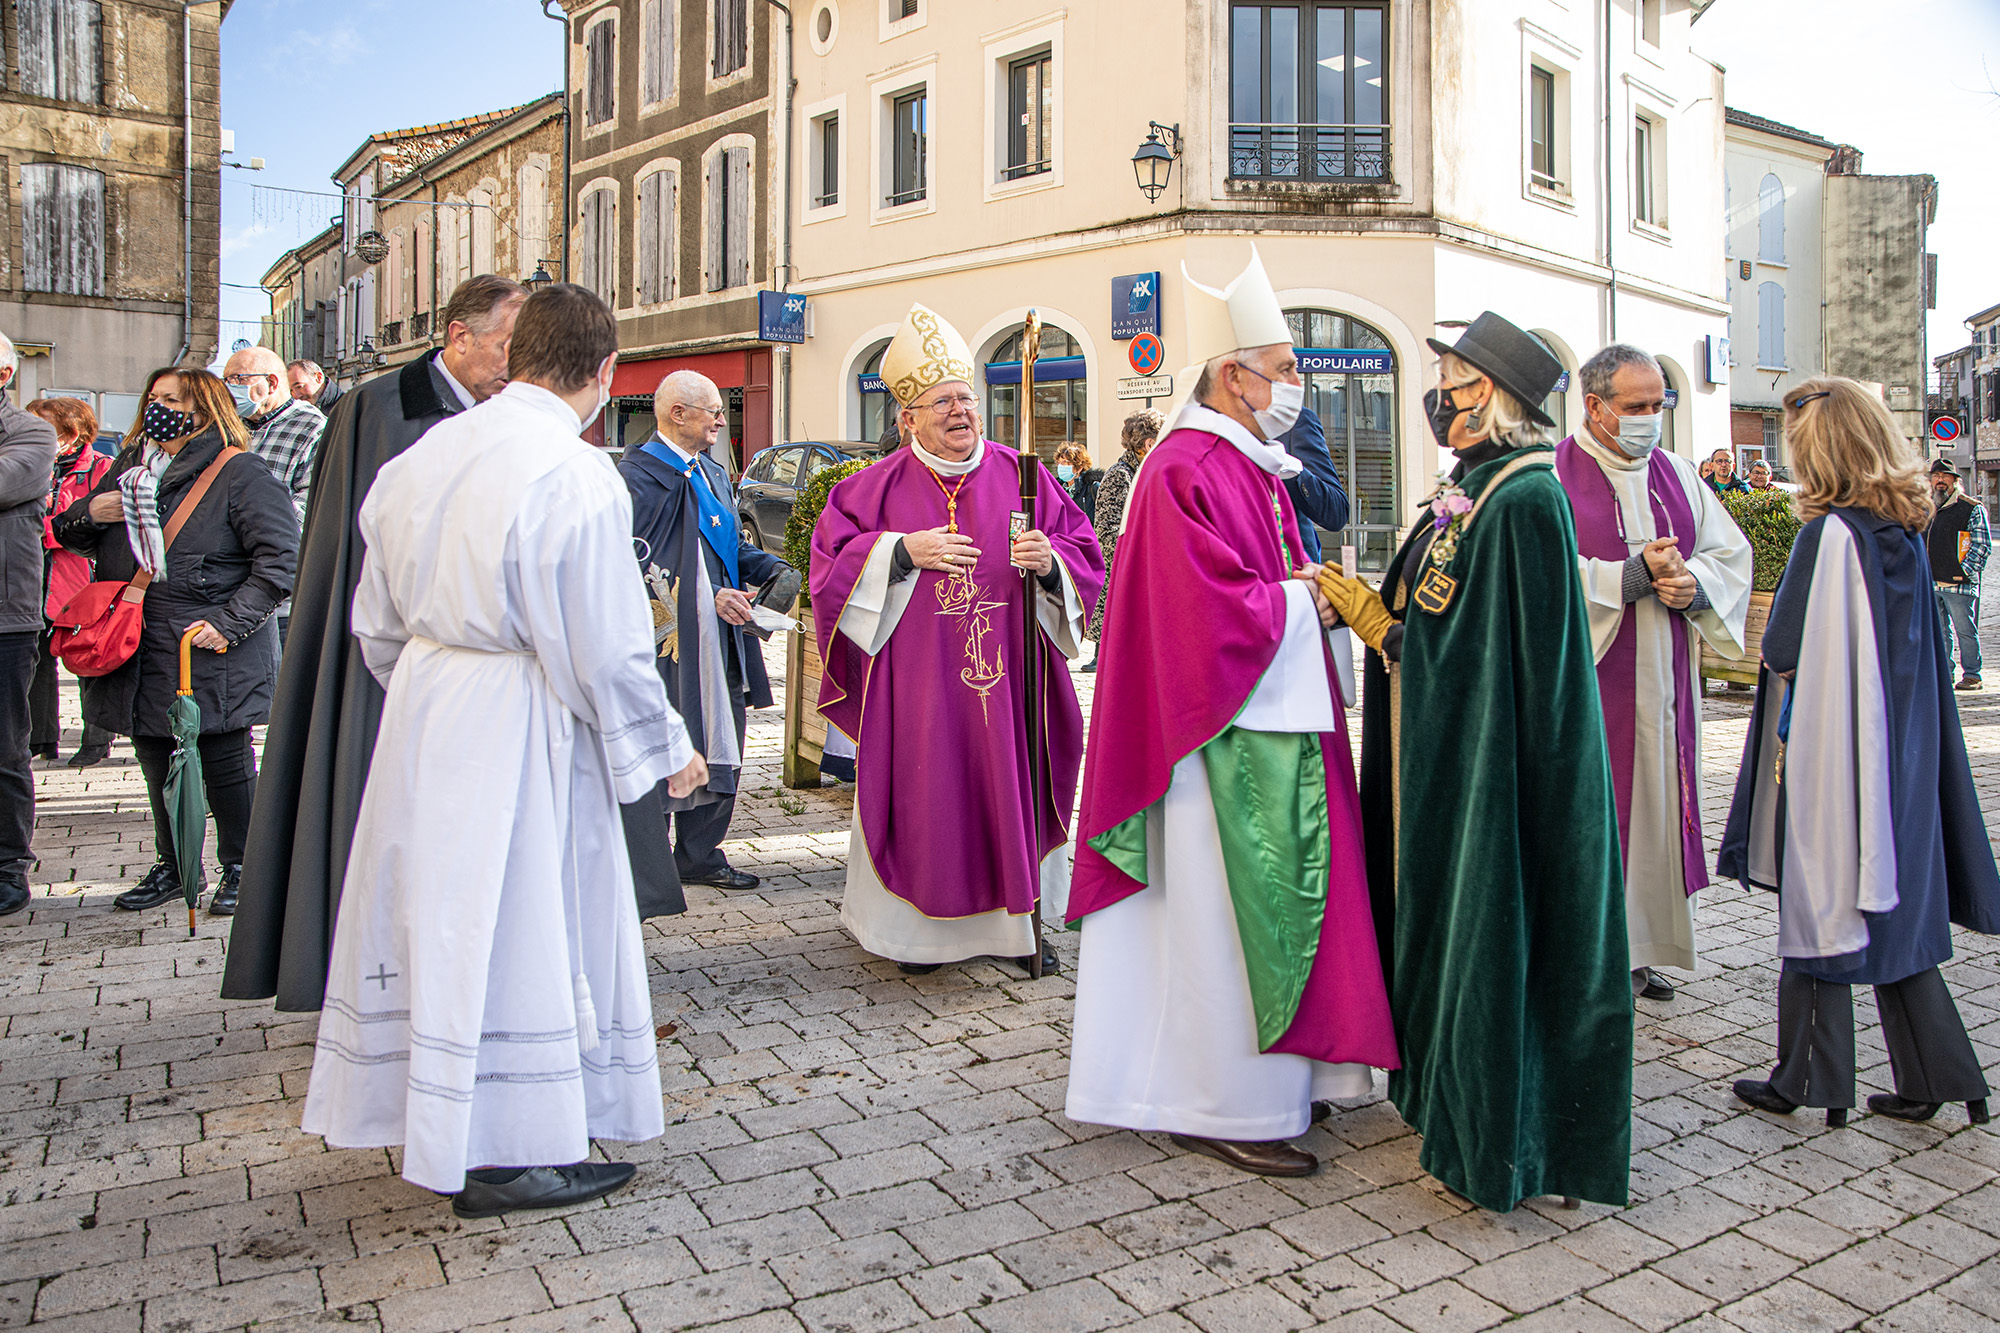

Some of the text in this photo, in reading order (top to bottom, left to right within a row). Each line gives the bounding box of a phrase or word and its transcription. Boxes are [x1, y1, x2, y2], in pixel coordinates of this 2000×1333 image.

[1113, 318, 1153, 327] BANQUE
[765, 326, 803, 334] BANQUE
[1113, 326, 1153, 335] POPULAIRE
[1303, 358, 1382, 369] POPULAIRE
[863, 380, 888, 390] BANQ
